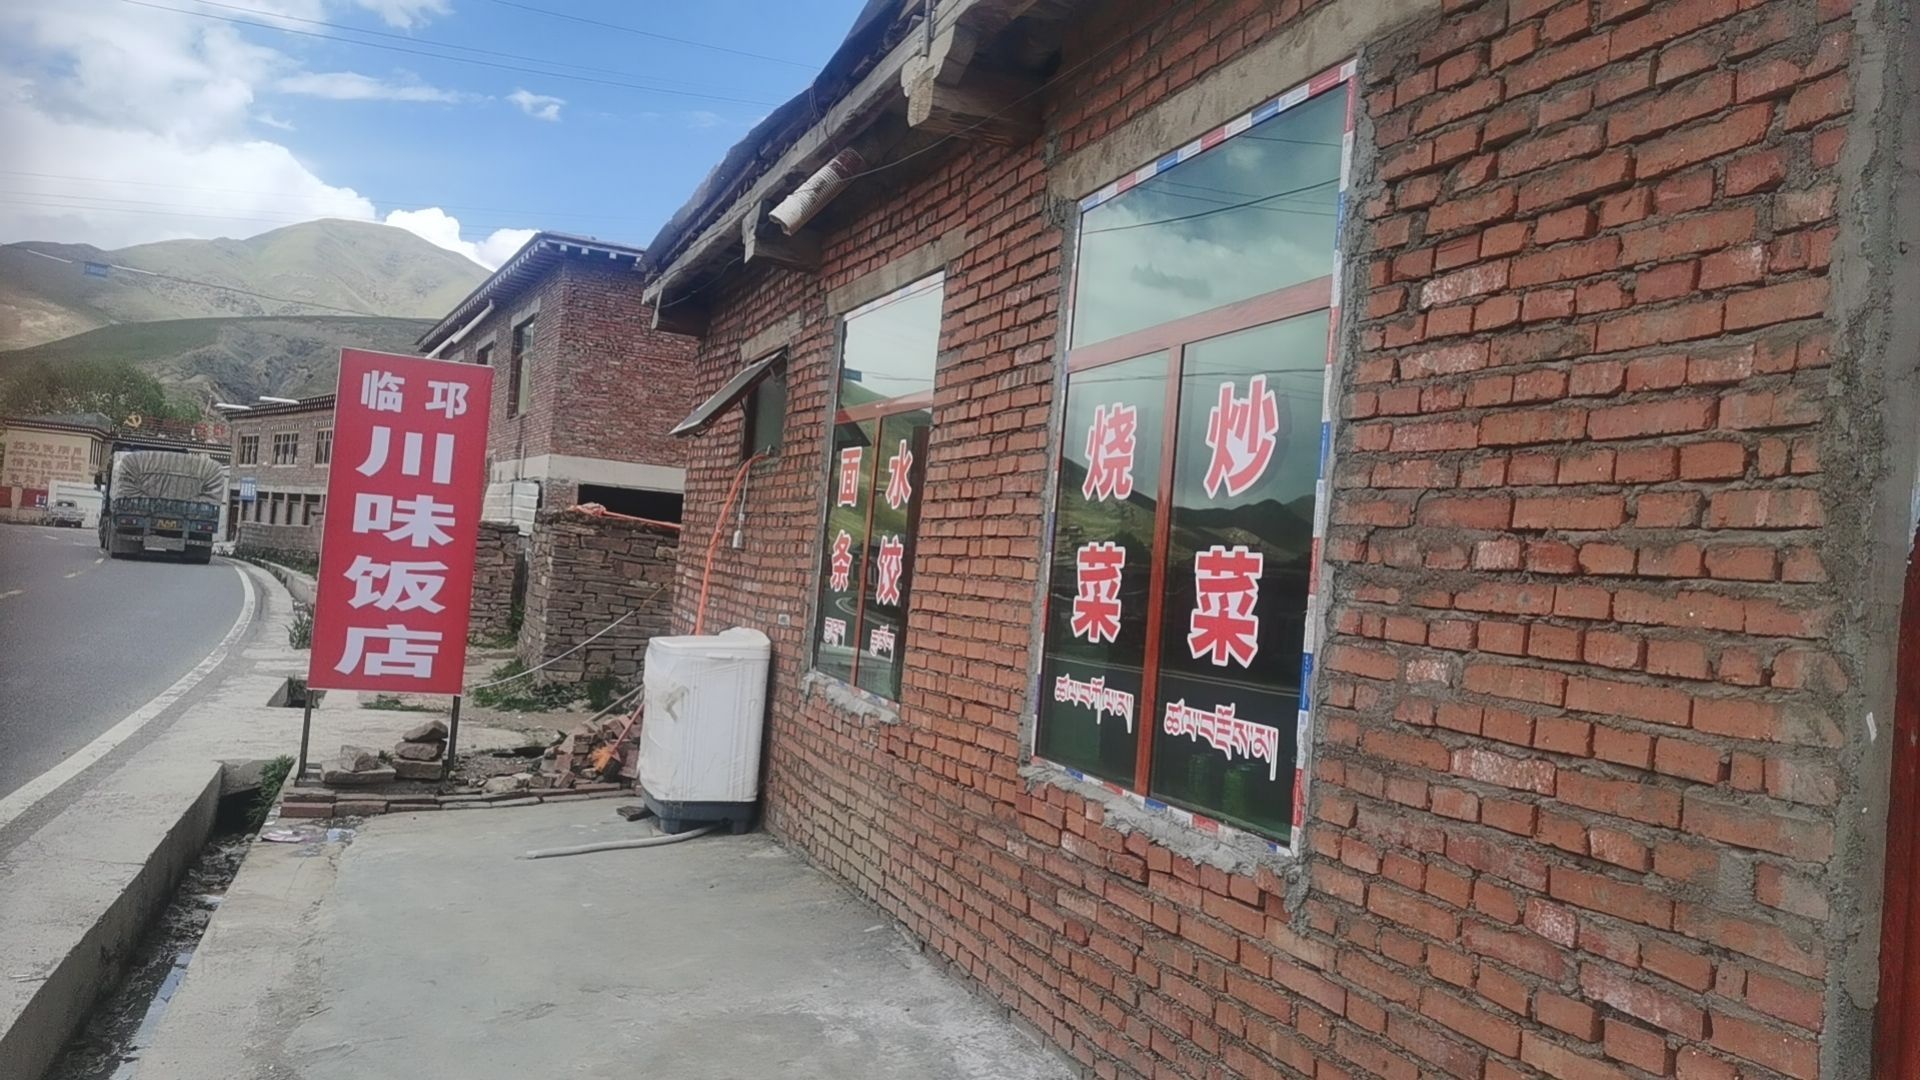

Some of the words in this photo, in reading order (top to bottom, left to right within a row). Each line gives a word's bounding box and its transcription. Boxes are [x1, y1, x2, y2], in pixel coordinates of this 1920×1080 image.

[360, 369, 470, 419] 临邛
[334, 426, 455, 678] 川味饭店
[830, 446, 862, 592] 面条
[876, 439, 913, 606] 水饺
[1071, 402, 1136, 643] 烧菜
[1187, 374, 1279, 668] 炒菜
